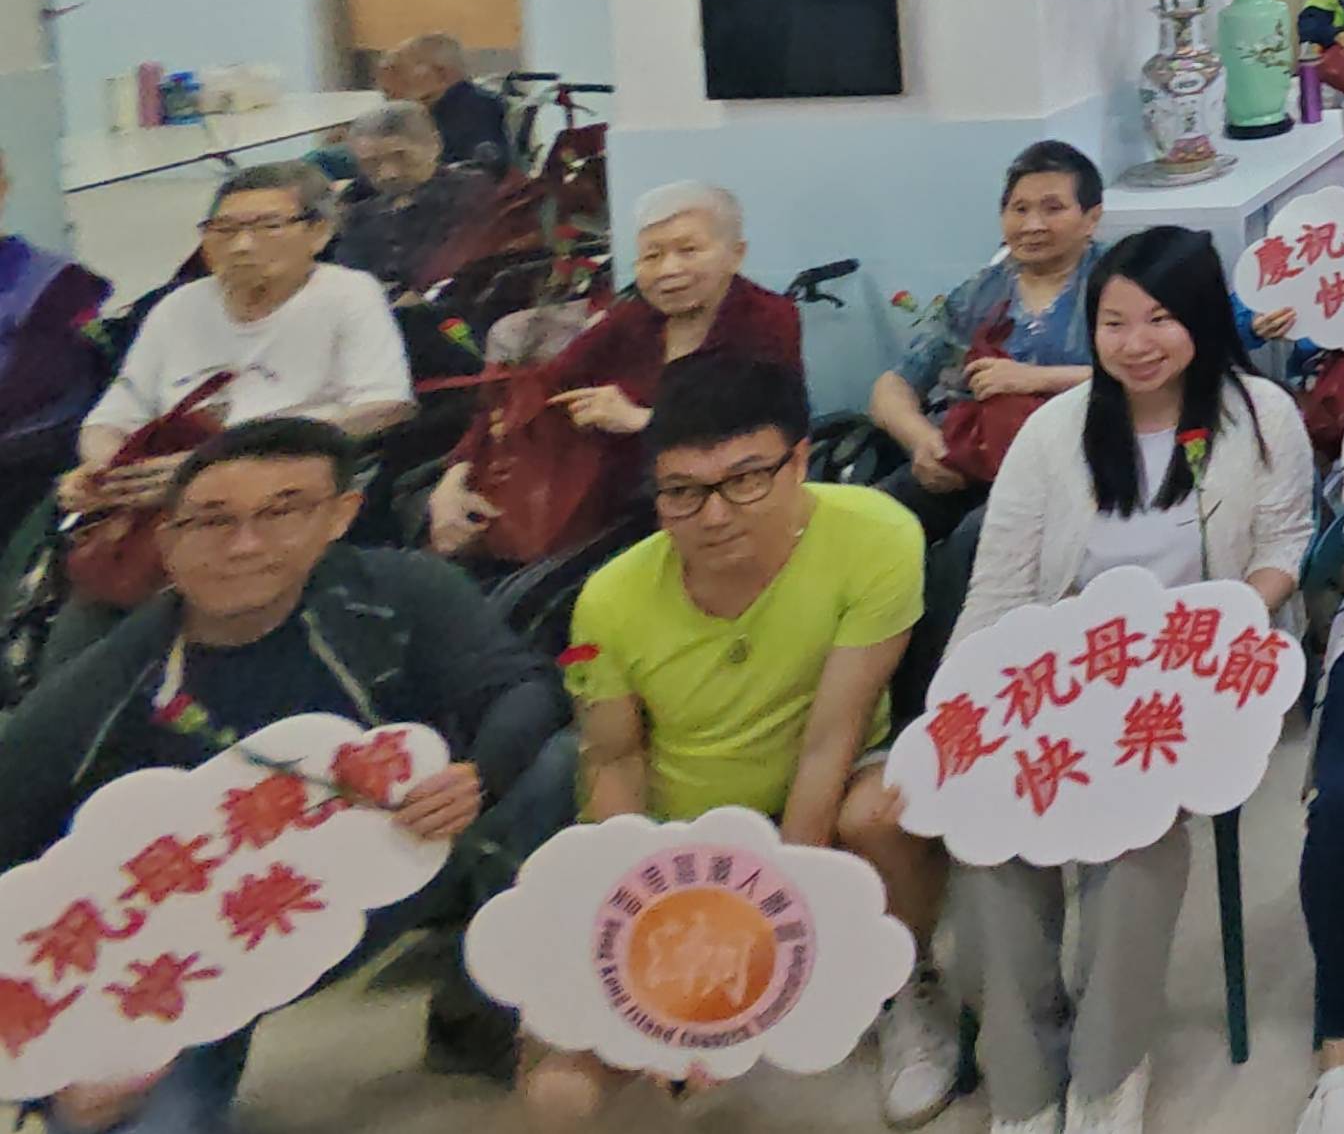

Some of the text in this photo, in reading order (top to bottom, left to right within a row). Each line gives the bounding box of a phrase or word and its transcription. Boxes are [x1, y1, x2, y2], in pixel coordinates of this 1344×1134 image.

[926, 600, 1290, 785] 慶祝母親節
[1015, 692, 1187, 815] 快樂
